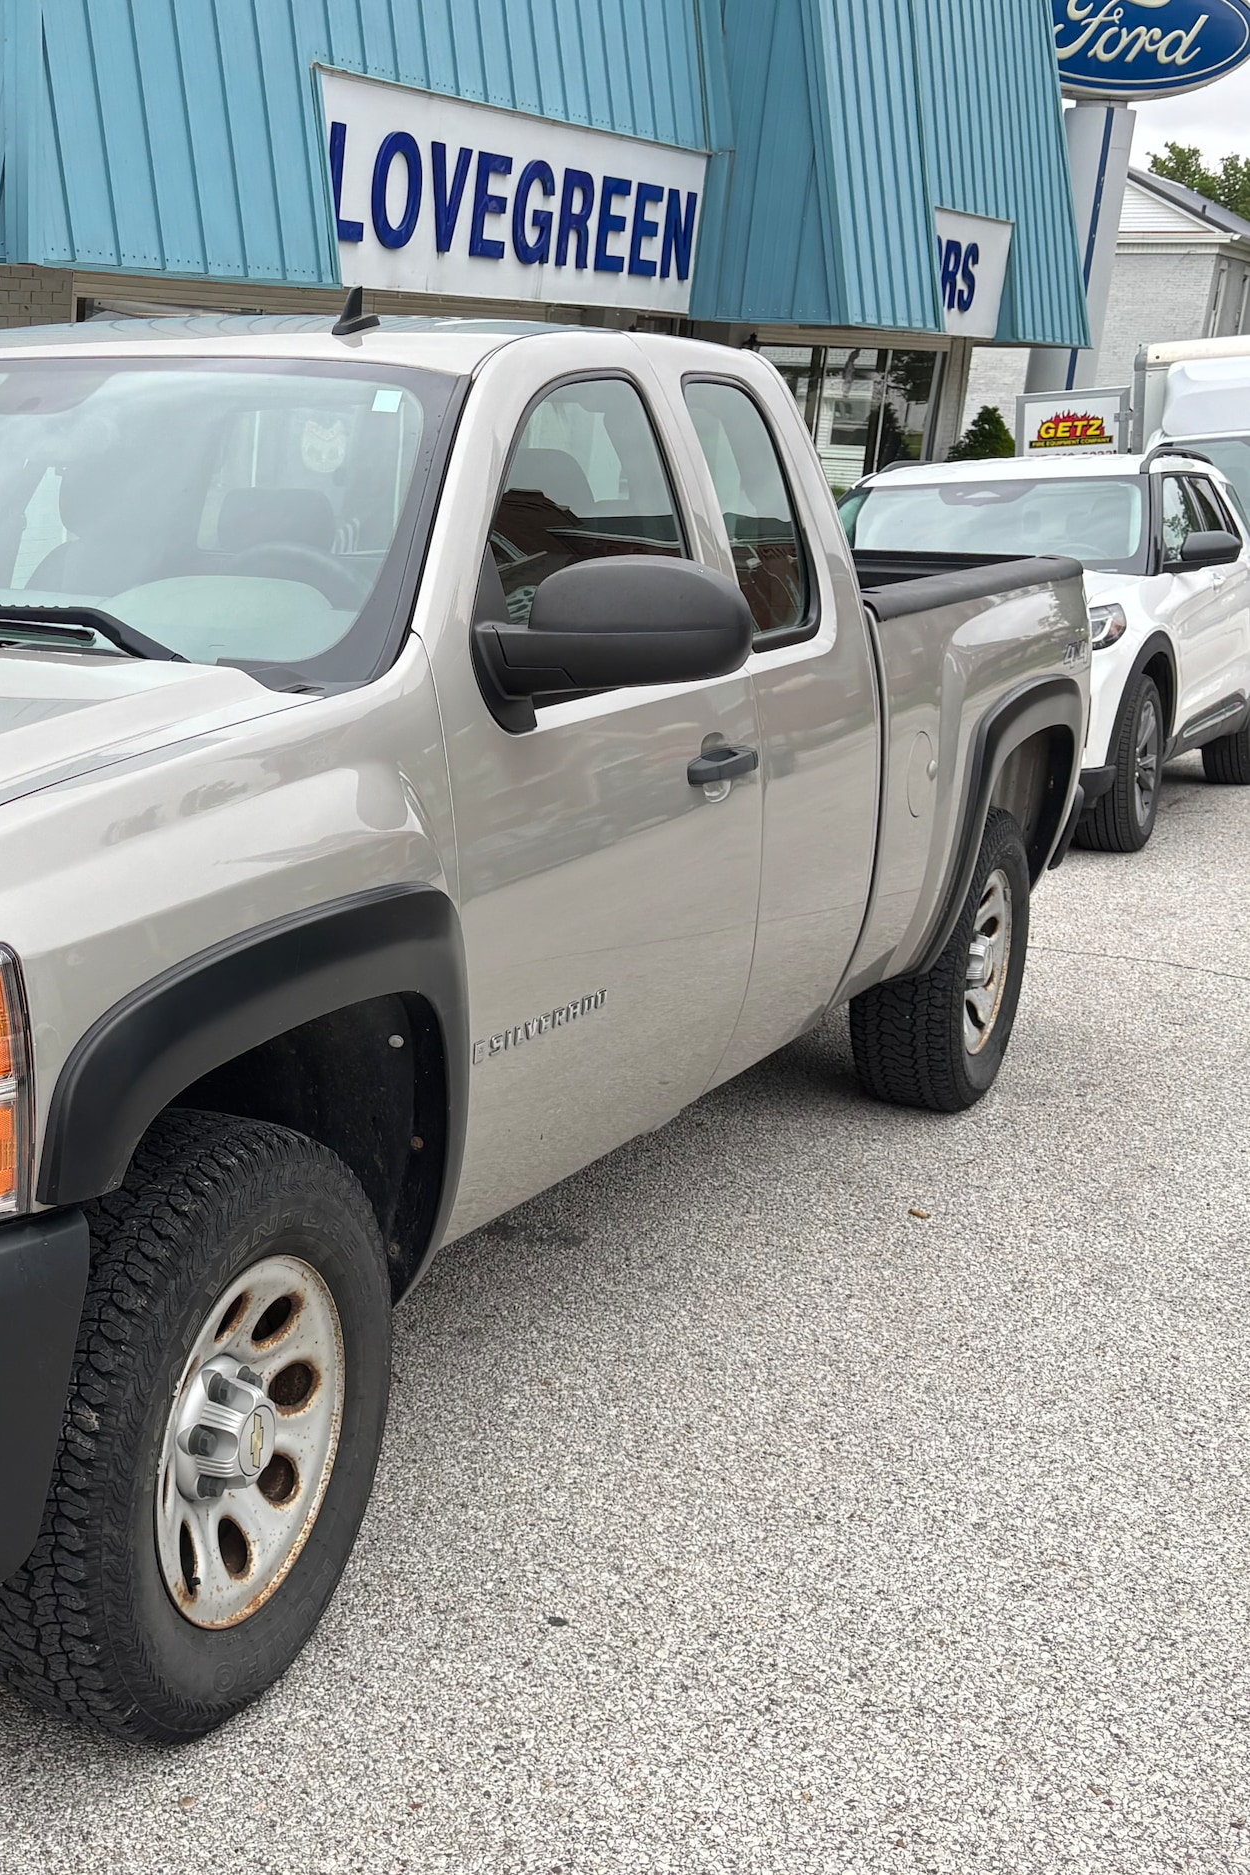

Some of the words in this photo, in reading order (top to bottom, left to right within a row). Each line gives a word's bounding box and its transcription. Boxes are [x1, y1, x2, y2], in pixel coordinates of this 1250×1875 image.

[1054, 0, 1210, 66] Ford
[329, 121, 698, 281] LOVEGREEN
[1031, 440, 1046, 448] FIRE
[1046, 438, 1080, 447] EQUIPMENT
[1080, 437, 1110, 445] COMPANY
[1039, 419, 1103, 439] GETZ
[489, 988, 608, 1057] SILVERADO
